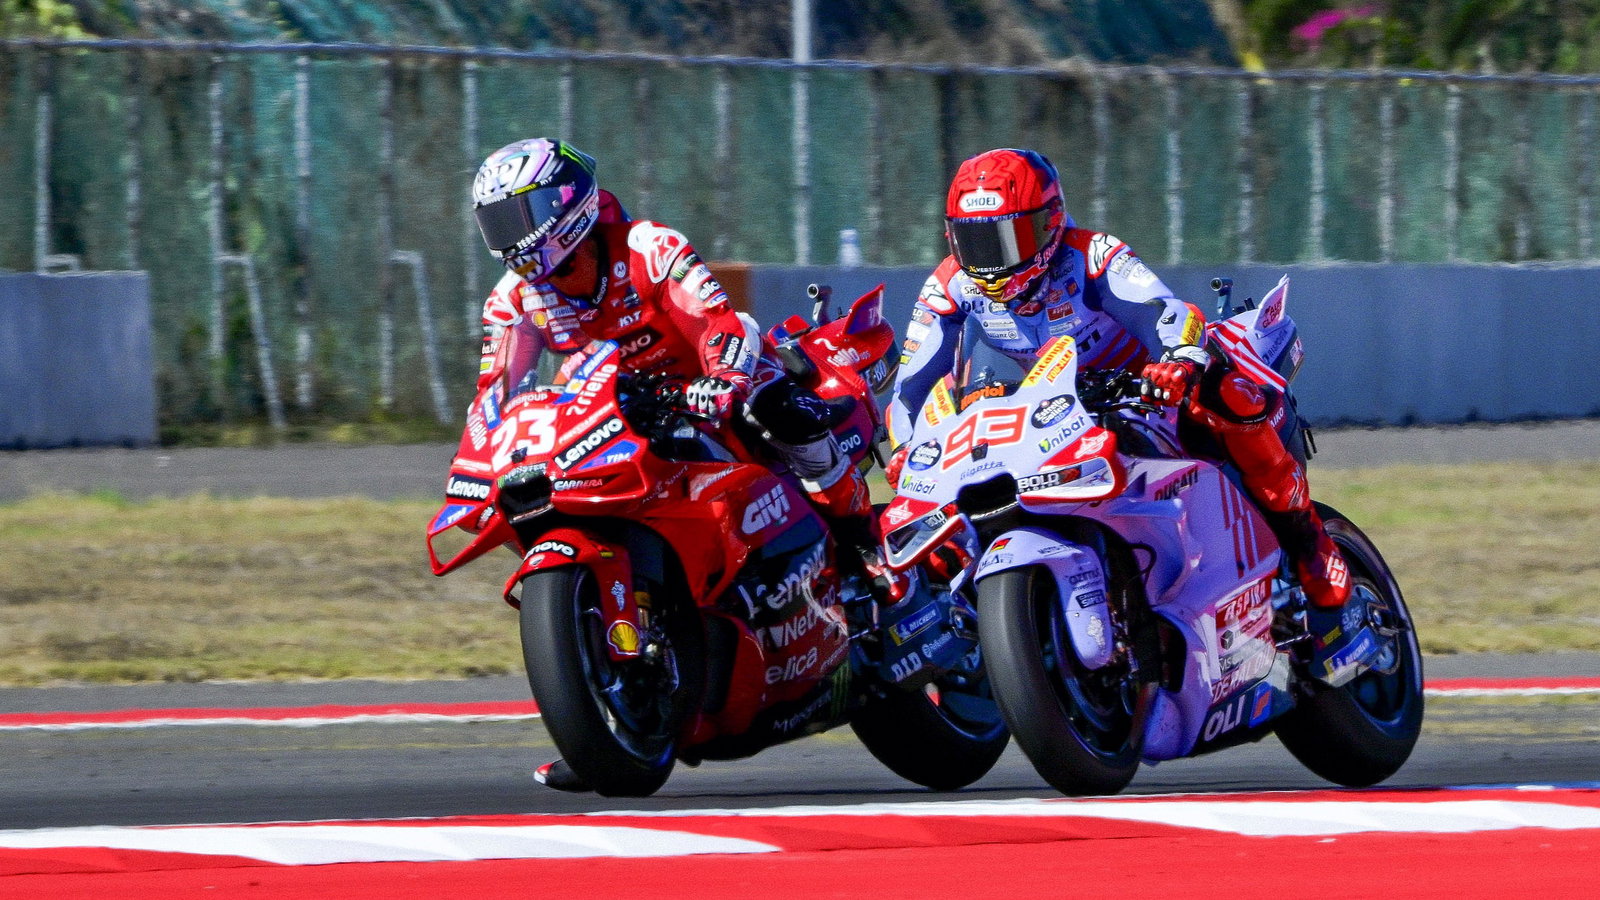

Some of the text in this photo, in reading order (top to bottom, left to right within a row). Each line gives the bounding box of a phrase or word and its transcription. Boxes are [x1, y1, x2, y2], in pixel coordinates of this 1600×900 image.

[965, 197, 997, 208] SHOEI
[562, 215, 588, 246] Lenovo
[576, 363, 618, 406] riello
[490, 408, 558, 473] 23
[554, 417, 623, 470] Lenovo
[942, 405, 1028, 471] 93
[1037, 415, 1086, 454] Unibat
[446, 476, 491, 499] Lenovo
[554, 478, 603, 491] CARRERA
[900, 474, 936, 495] Unibat
[1016, 472, 1060, 489] BOLD
[1154, 465, 1199, 502] DUCATI
[741, 483, 791, 534] GIVI
[1223, 581, 1267, 622] ASPIRA
[765, 646, 818, 684] elica
[1204, 694, 1246, 742] OLI
